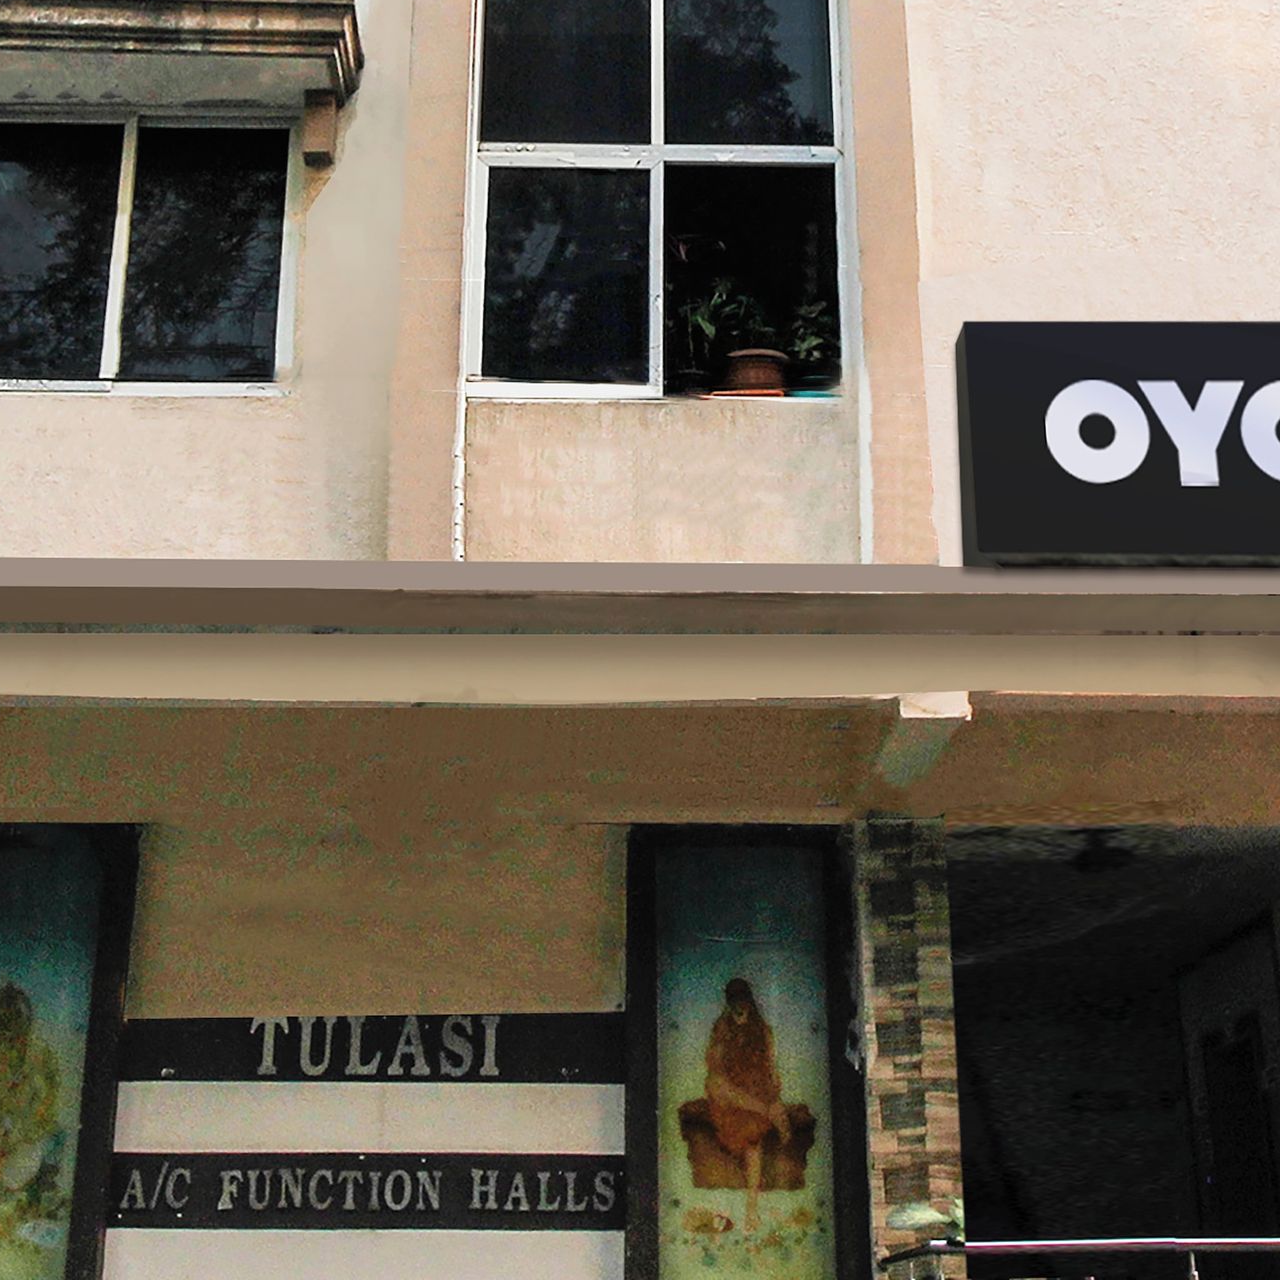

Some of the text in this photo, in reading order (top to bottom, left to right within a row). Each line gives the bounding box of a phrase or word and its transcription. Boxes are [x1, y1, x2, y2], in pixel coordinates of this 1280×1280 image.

[250, 1016, 500, 1077] TULASI
[120, 1161, 617, 1212] A/C FUNCTION HALLS
